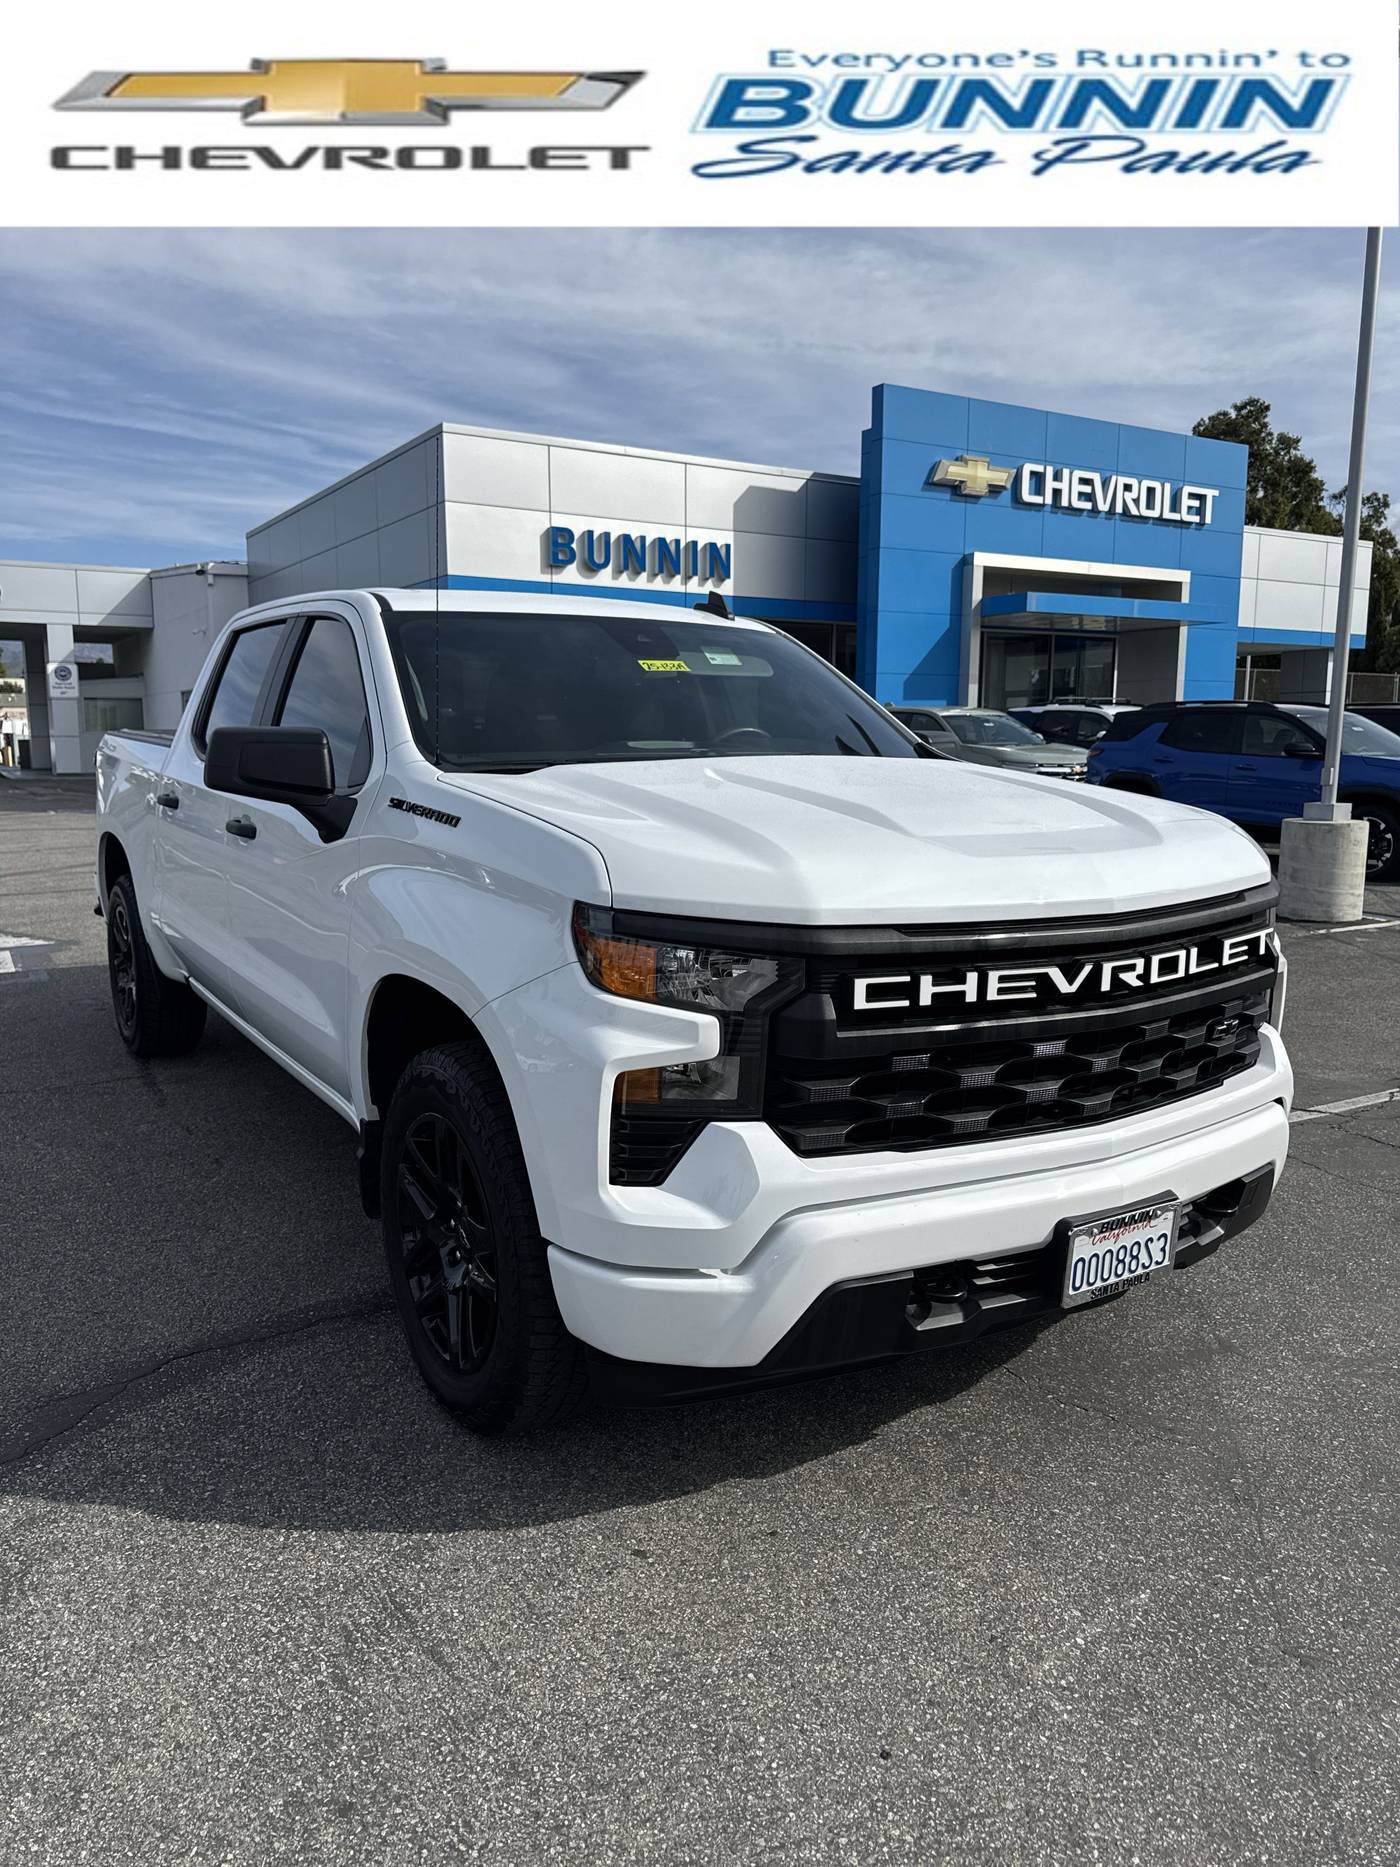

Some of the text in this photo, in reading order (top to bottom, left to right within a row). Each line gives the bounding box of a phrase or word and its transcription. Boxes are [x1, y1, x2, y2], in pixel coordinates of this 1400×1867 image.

[1018, 462, 1219, 524] CHEVROLET
[548, 526, 731, 579] BUNNIN
[387, 797, 461, 828] SILVERADO
[853, 927, 1274, 1010] CHEVROLET
[1099, 1208, 1155, 1234] BUNNIN
[1090, 1272, 1150, 1300] SANTA PAULA
